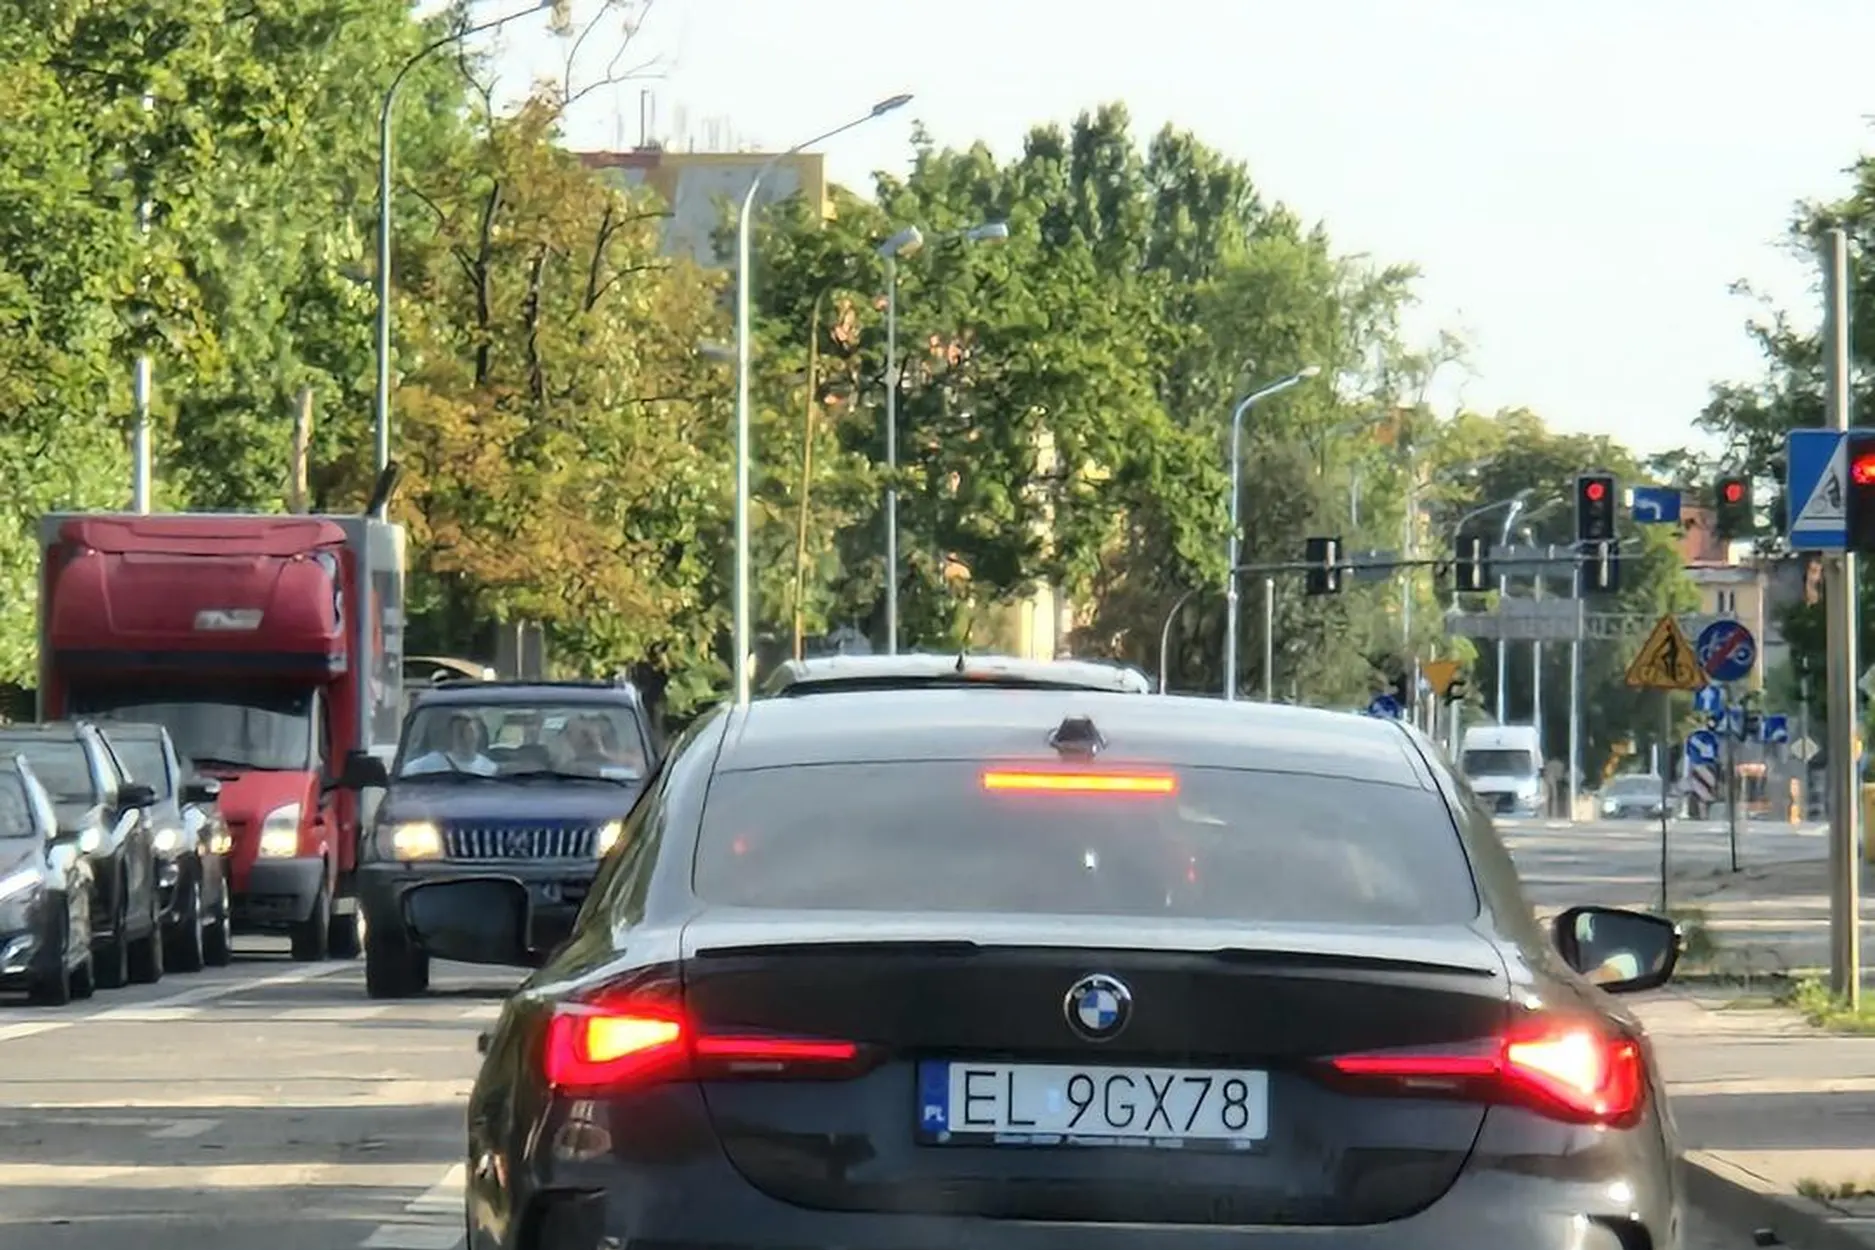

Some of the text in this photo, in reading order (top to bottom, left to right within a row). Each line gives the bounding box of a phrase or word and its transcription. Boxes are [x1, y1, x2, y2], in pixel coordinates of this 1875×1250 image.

[923, 1104, 945, 1122] PL
[964, 1071, 1249, 1132] EL 9GX78
